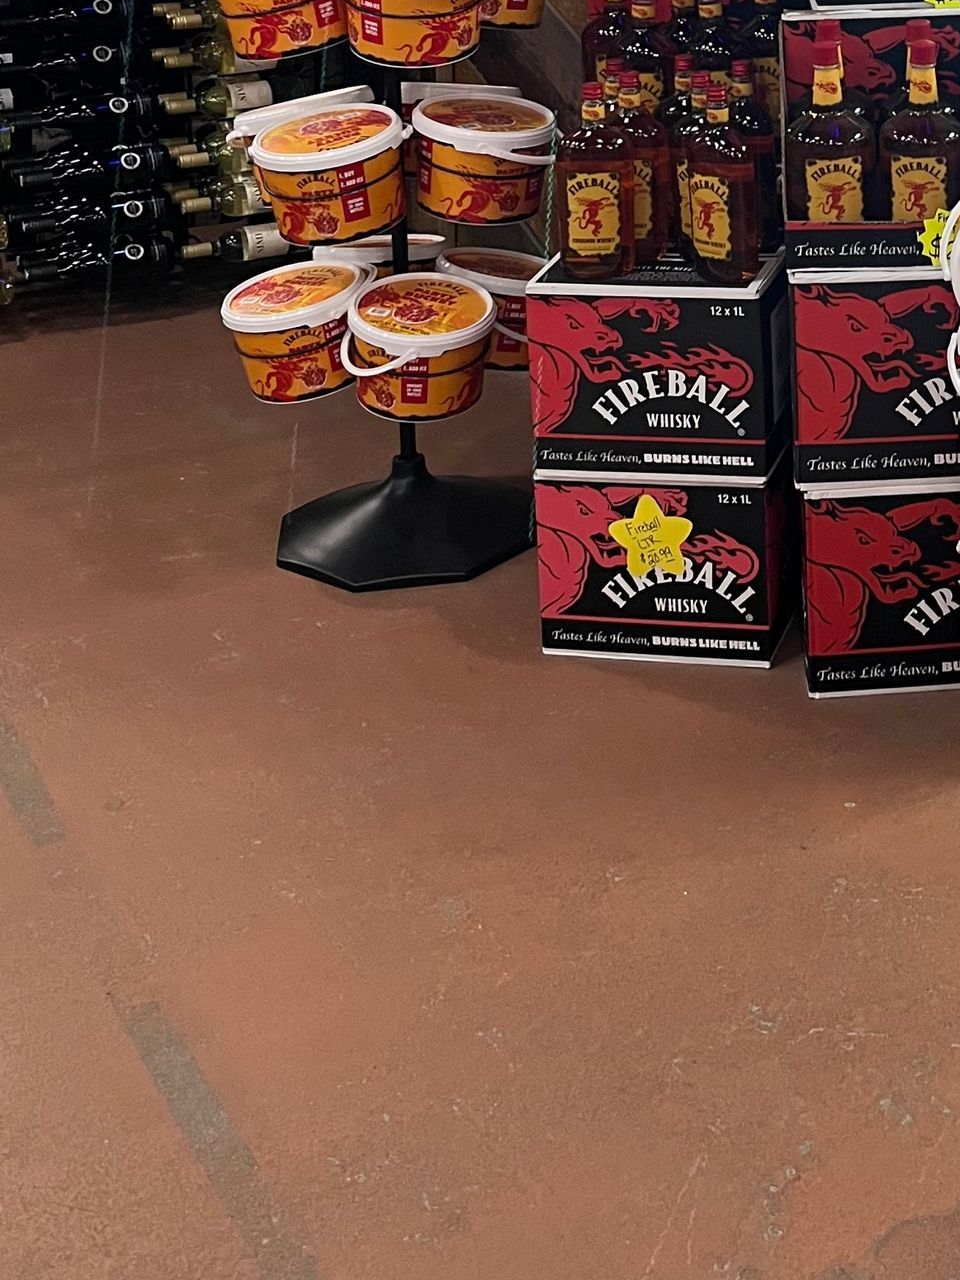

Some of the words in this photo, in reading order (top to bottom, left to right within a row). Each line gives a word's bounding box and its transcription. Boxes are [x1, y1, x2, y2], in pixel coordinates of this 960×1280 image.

[810, 164, 861, 183] FIREBALL
[895, 162, 946, 181] FIREBALL
[568, 177, 618, 197] FIREBALL
[690, 180, 727, 203] FIREBALL
[794, 243, 835, 257] Tastes
[839, 243, 867, 256] Like
[870, 242, 921, 257] Heaven,
[710, 306, 722, 316] 12
[732, 307, 745, 317] 1L
[282, 329, 323, 347] FIREBALL
[592, 369, 750, 430] FIREBALL
[646, 412, 701, 429] WHISKY
[540, 448, 573, 461] Tastes
[575, 450, 598, 462] Like
[600, 450, 642, 464] Heaven,
[643, 453, 689, 464] BURNS
[691, 454, 721, 465] LIKE
[722, 455, 755, 466] HELL
[807, 456, 847, 470] Tastes
[851, 455, 877, 469] Like
[881, 455, 932, 469] Heaven,
[717, 493, 730, 504] 12
[731, 496, 738, 504] x
[740, 494, 752, 505] 1L
[625, 515, 661, 536] Fireball
[654, 597, 708, 614] WHISKY
[552, 630, 584, 642] Tastes
[585, 631, 608, 643] Like
[610, 631, 650, 647] Heaven,
[652, 635, 698, 647] BURNS
[699, 637, 728, 649] LIKE
[729, 639, 761, 651] HELL
[817, 667, 858, 682] Tastes
[862, 665, 889, 679] Like
[890, 662, 940, 678] Heaven,
